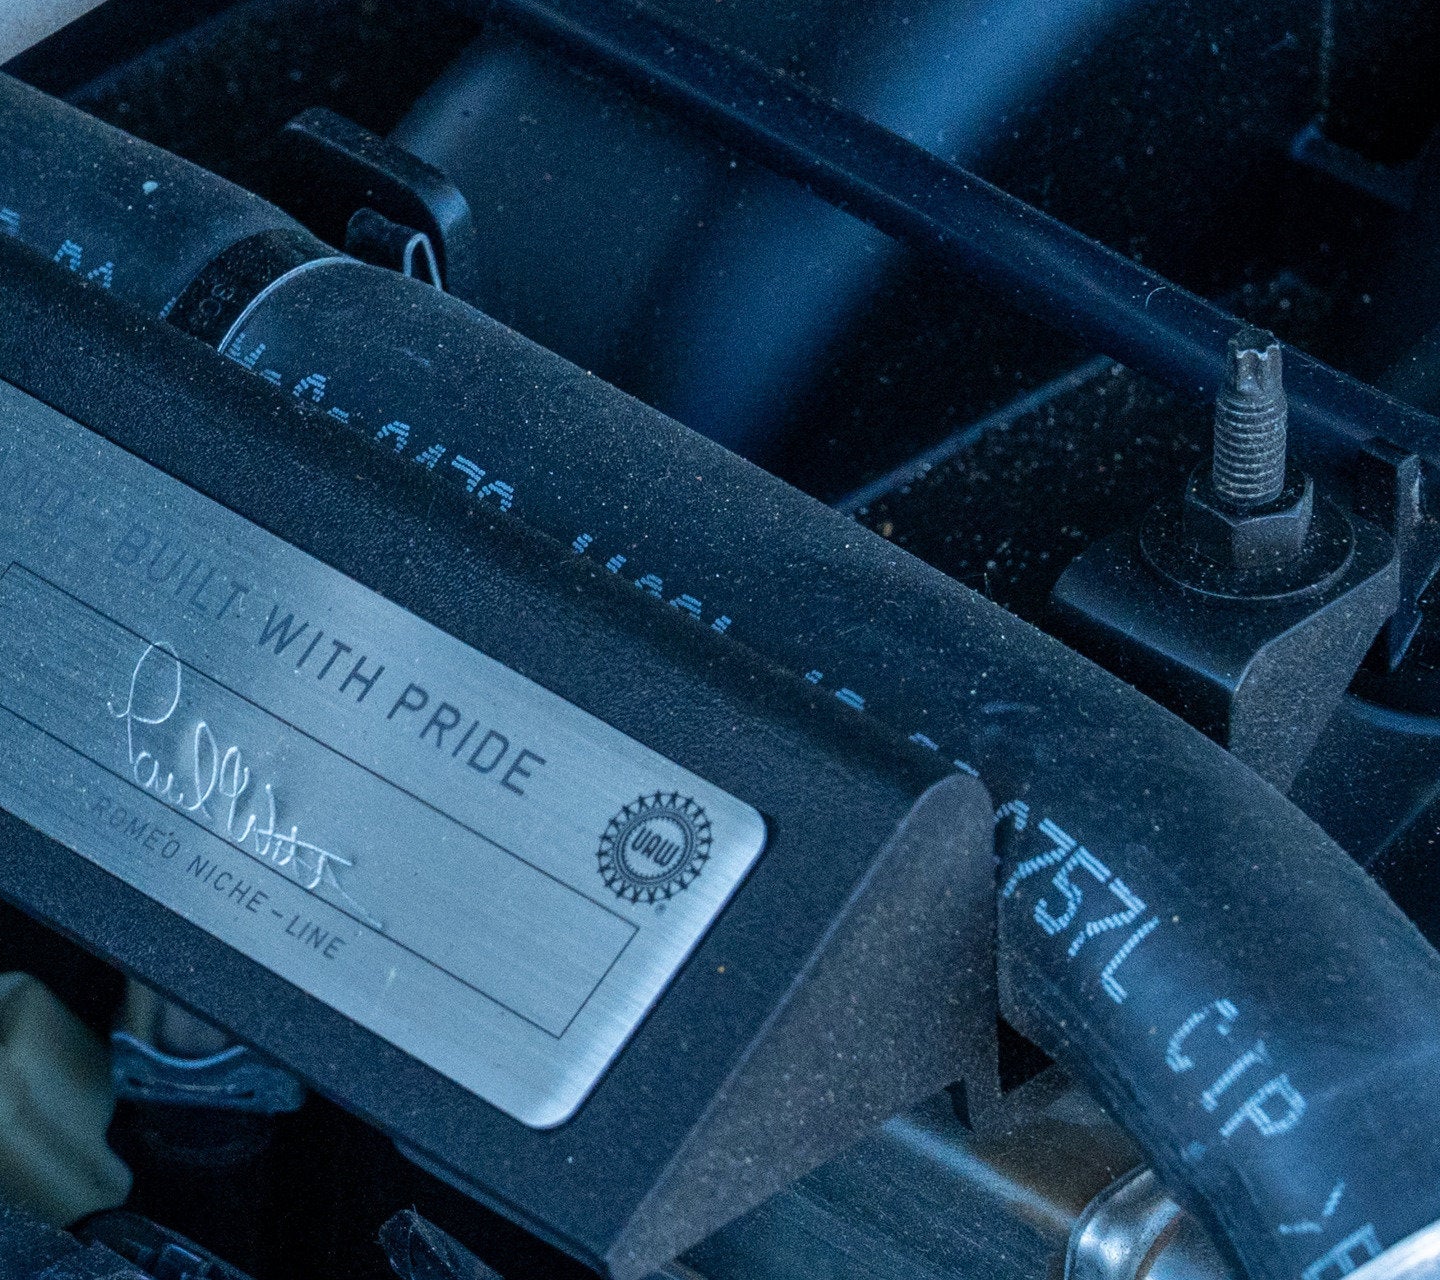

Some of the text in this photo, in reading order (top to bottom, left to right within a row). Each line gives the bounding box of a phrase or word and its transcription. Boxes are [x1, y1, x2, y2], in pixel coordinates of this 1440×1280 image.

[259, 604, 386, 703] WITH
[387, 682, 547, 796] PRIDE
[631, 826, 681, 867] UAW
